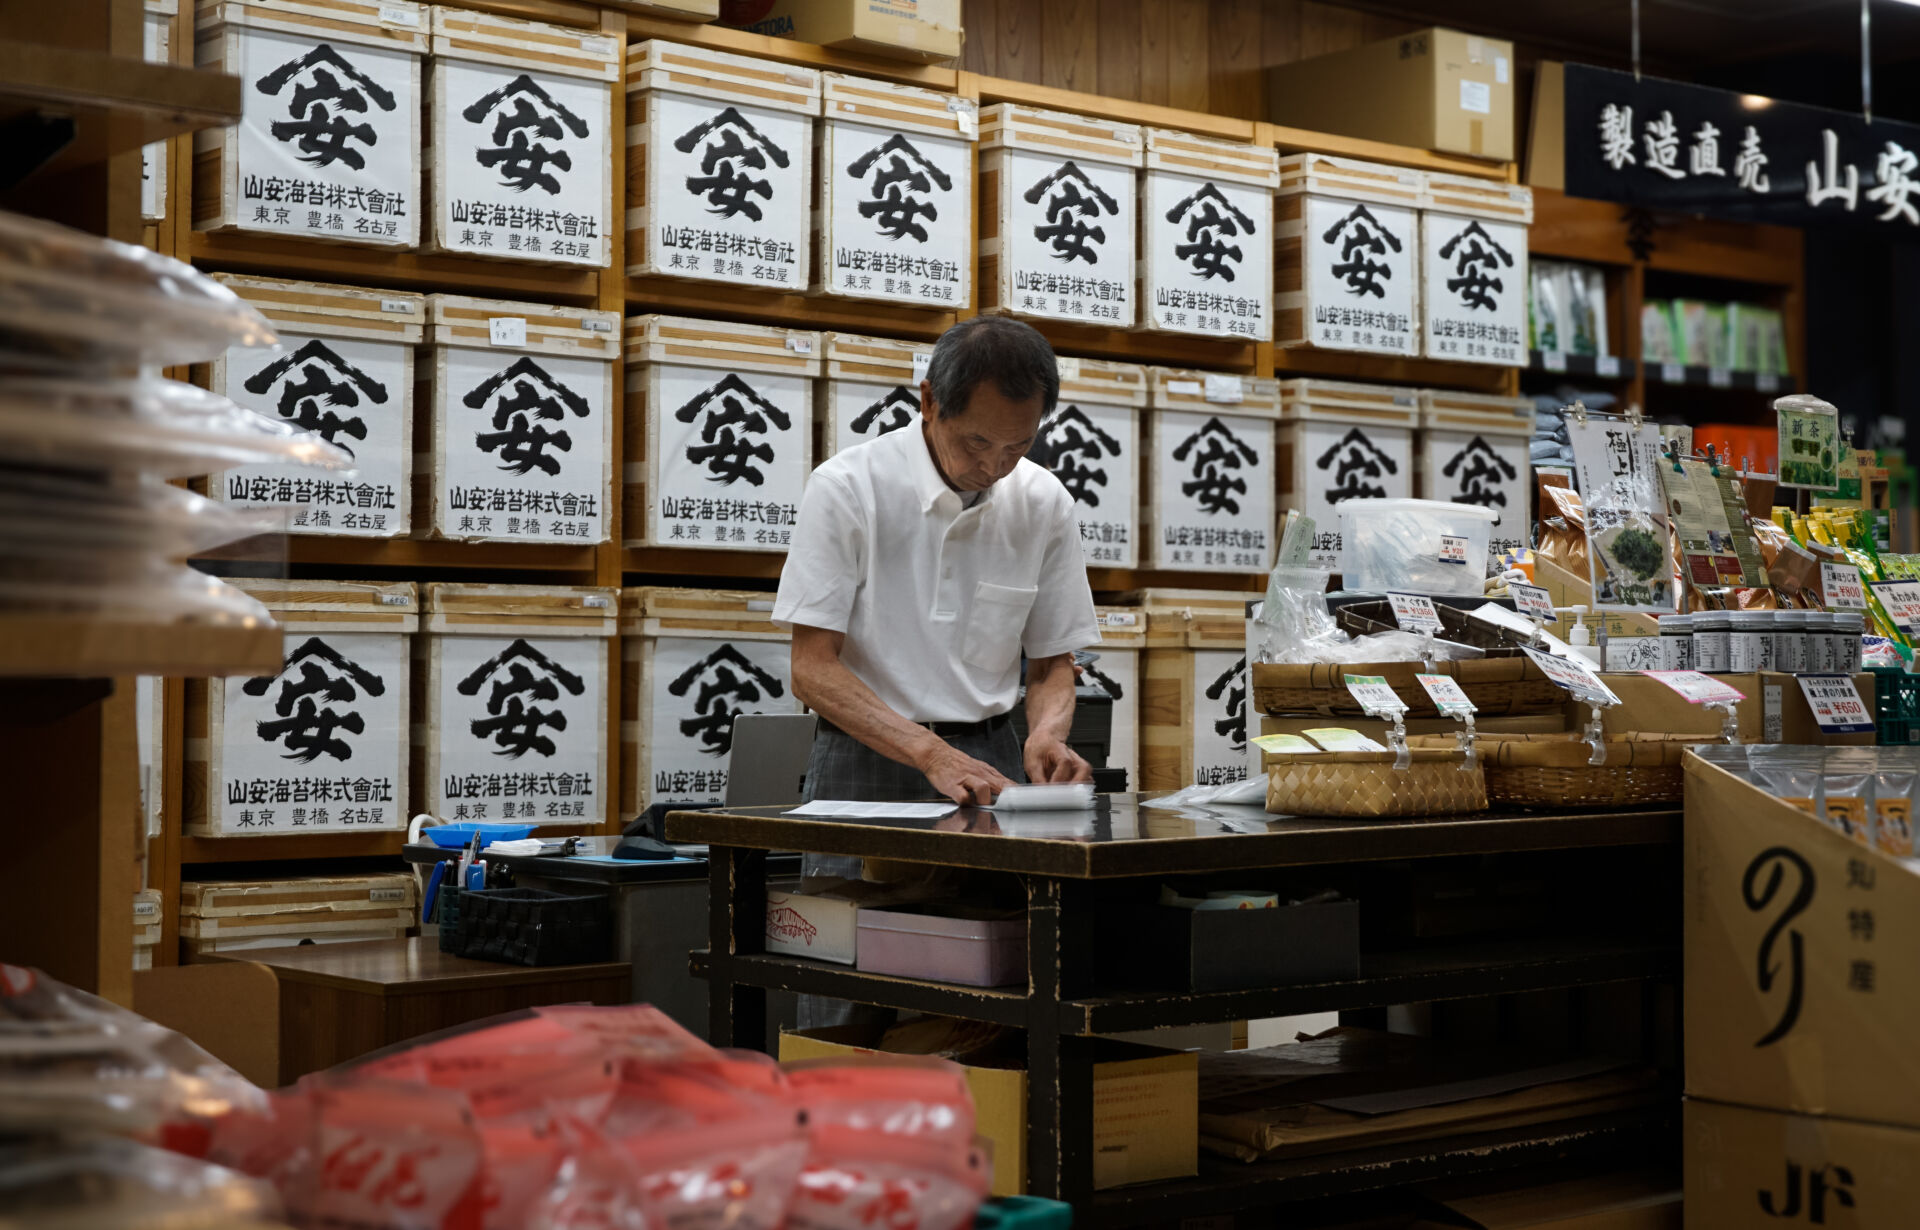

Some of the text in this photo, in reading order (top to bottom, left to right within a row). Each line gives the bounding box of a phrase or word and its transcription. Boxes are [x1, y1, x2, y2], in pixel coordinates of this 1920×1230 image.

[271, 68, 377, 170] 安
[476, 98, 572, 195] 安
[686, 129, 773, 222] 安
[1598, 103, 1920, 227] 製造直売 山安
[245, 175, 405, 217] 山安海苔株式會社
[858, 154, 937, 243] 安
[252, 206, 398, 237] 東京 豊橋 名古屋
[451, 200, 597, 239] 山安海苔株式會社
[1034, 181, 1105, 264] 安
[460, 229, 591, 258] 東京 豊橋 名古屋
[662, 225, 795, 264] 山安海苔株式會社
[1176, 202, 1242, 282] 安
[670, 254, 788, 282] 東京 豊橋 名古屋
[837, 248, 958, 282] 山安海苔株式會社
[1332, 222, 1391, 298] 安
[1447, 239, 1503, 312] 安
[844, 274, 953, 300] 東京 豊橋 名古屋
[1015, 270, 1125, 302] 山安海苔株式會社
[1157, 287, 1261, 318] 山安海苔株式會社
[1023, 296, 1120, 319] 東京 豊橋 名古屋
[1164, 312, 1256, 334] 東京 豊橋 名古屋
[1316, 305, 1409, 332] 山安海苔株式會社
[476, 379, 572, 476] 安
[686, 395, 774, 487] 安
[1791, 418, 1820, 439] 新茶
[1182, 437, 1247, 515] 安
[230, 476, 396, 510] 山安海苔株式會社
[450, 486, 597, 518] 山安海苔株式會社
[341, 513, 387, 530] 名古屋
[460, 516, 590, 537] 東京 豊橋 名古屋
[662, 497, 798, 526] 山安海苔株式會社
[669, 524, 791, 544] 東京 豊橋 名古屋
[1838, 585, 1861, 598] ¥800
[257, 662, 365, 765] 安
[471, 663, 567, 760] 安
[1832, 701, 1861, 714] ¥650
[656, 770, 728, 793] 山安海苔
[237, 808, 384, 827] 東京 豊橋 名古屋
[454, 802, 585, 819] 東京 豊橋 名古屋
[1742, 846, 1817, 1048] のり
